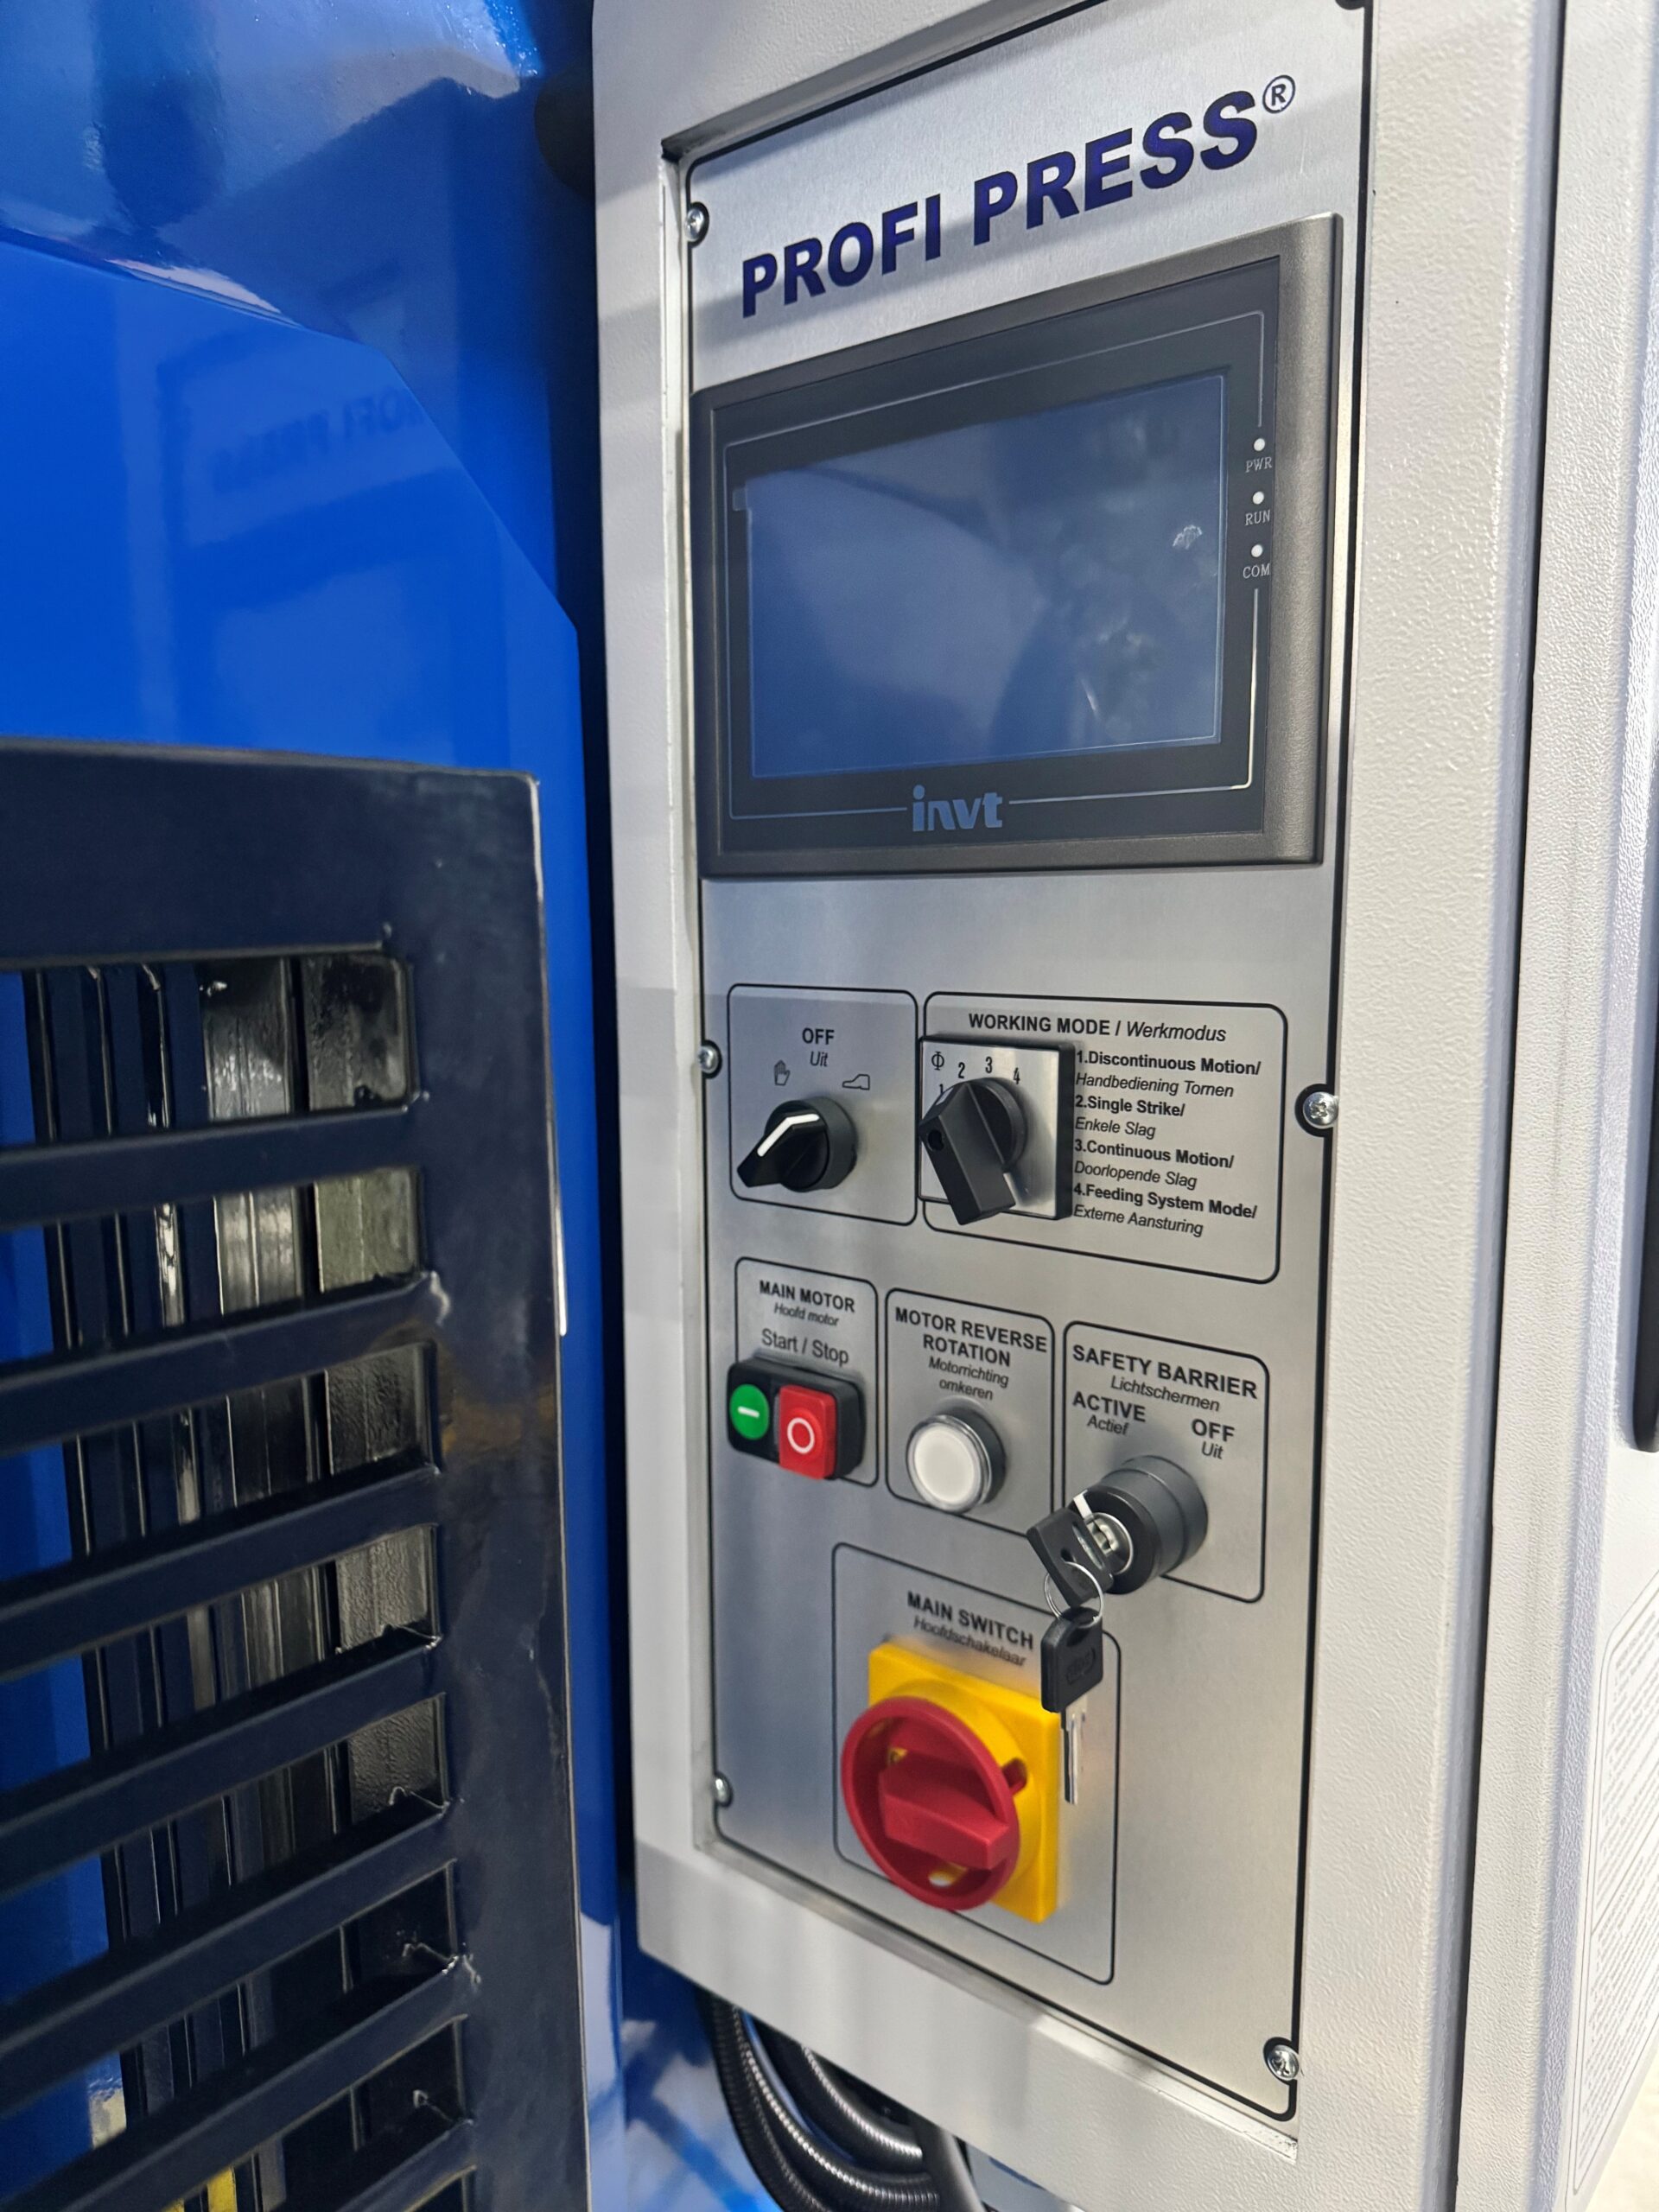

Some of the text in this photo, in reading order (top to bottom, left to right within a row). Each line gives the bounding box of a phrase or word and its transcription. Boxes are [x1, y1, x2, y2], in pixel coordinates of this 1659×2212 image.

[741, 194, 942, 320] PROFI
[1245, 456, 1273, 473] PWR
[1244, 510, 1271, 526] RUN
[1243, 563, 1270, 579] COM
[912, 784, 1004, 832] invt
[801, 1027, 835, 1045] OFF
[969, 1013, 1052, 1032] WORKING
[1057, 1017, 1110, 1035] MODE
[1127, 1020, 1227, 1042] Werkmodus
[809, 1051, 829, 1067] Uit
[957, 1062, 966, 1079] 2
[984, 1056, 994, 1073] 3
[1013, 1067, 1021, 1085] 4
[1076, 1051, 1262, 1075] 1.Discontinuous Motion/
[1076, 1072, 1179, 1096] Handbediening
[1075, 1095, 1185, 1117] 2.Single Strike/
[1075, 1116, 1156, 1141] Enkele Slag
[1074, 1139, 1235, 1168] 3.Continuous Motion/
[1074, 1160, 1198, 1191] Doorlopende Slag
[1073, 1183, 1258, 1218] 4.Feeding System Mode/
[1128, 1211, 1204, 1237] Aansturing
[760, 1280, 855, 1313] MAIN MOTOR
[808, 1312, 839, 1326] motor
[895, 1306, 1047, 1352] MOTOR REVERSE
[761, 1328, 798, 1352] Start
[811, 1339, 849, 1367] Stop
[923, 1334, 1011, 1367] ROTATION
[1072, 1344, 1257, 1399] SAFETY BARRIER
[938, 1379, 993, 1401] omkeren
[1110, 1376, 1220, 1412] Lichtschermen
[1072, 1391, 1146, 1422] ACTIVE
[1086, 1414, 1129, 1435] Actief
[1191, 1418, 1235, 1442] OFF
[1201, 1440, 1224, 1459] Uit
[907, 1591, 1033, 1649] MAIN SWITCH
